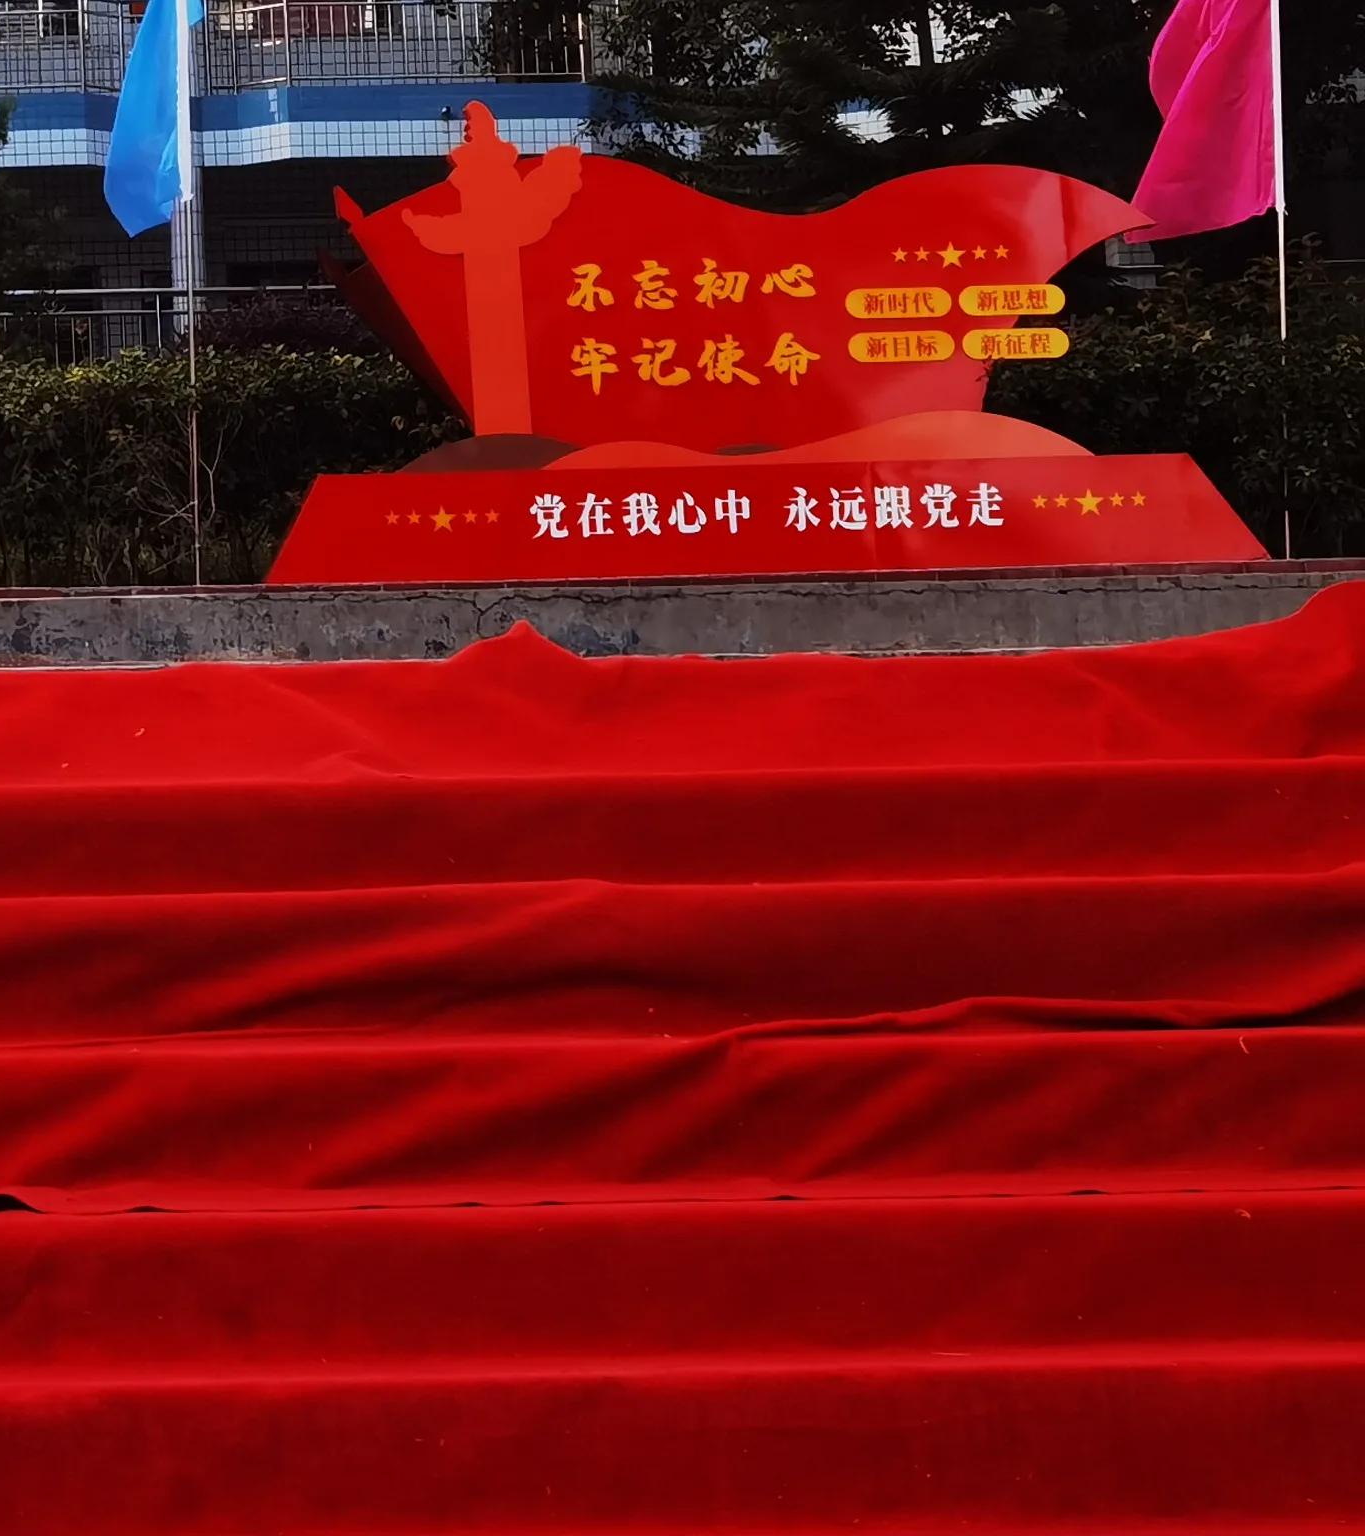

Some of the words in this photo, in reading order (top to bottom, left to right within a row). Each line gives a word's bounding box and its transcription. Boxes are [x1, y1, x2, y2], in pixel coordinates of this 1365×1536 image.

[565, 257, 817, 313] 不忘初心
[862, 292, 936, 315] 新时代
[975, 287, 1049, 312] 新思想
[865, 334, 939, 359] 新目标
[980, 332, 1054, 357] 新征程
[569, 331, 822, 397] 牢记使命
[528, 488, 752, 540] 党在我心中
[782, 482, 1005, 532] 永远跟党走
